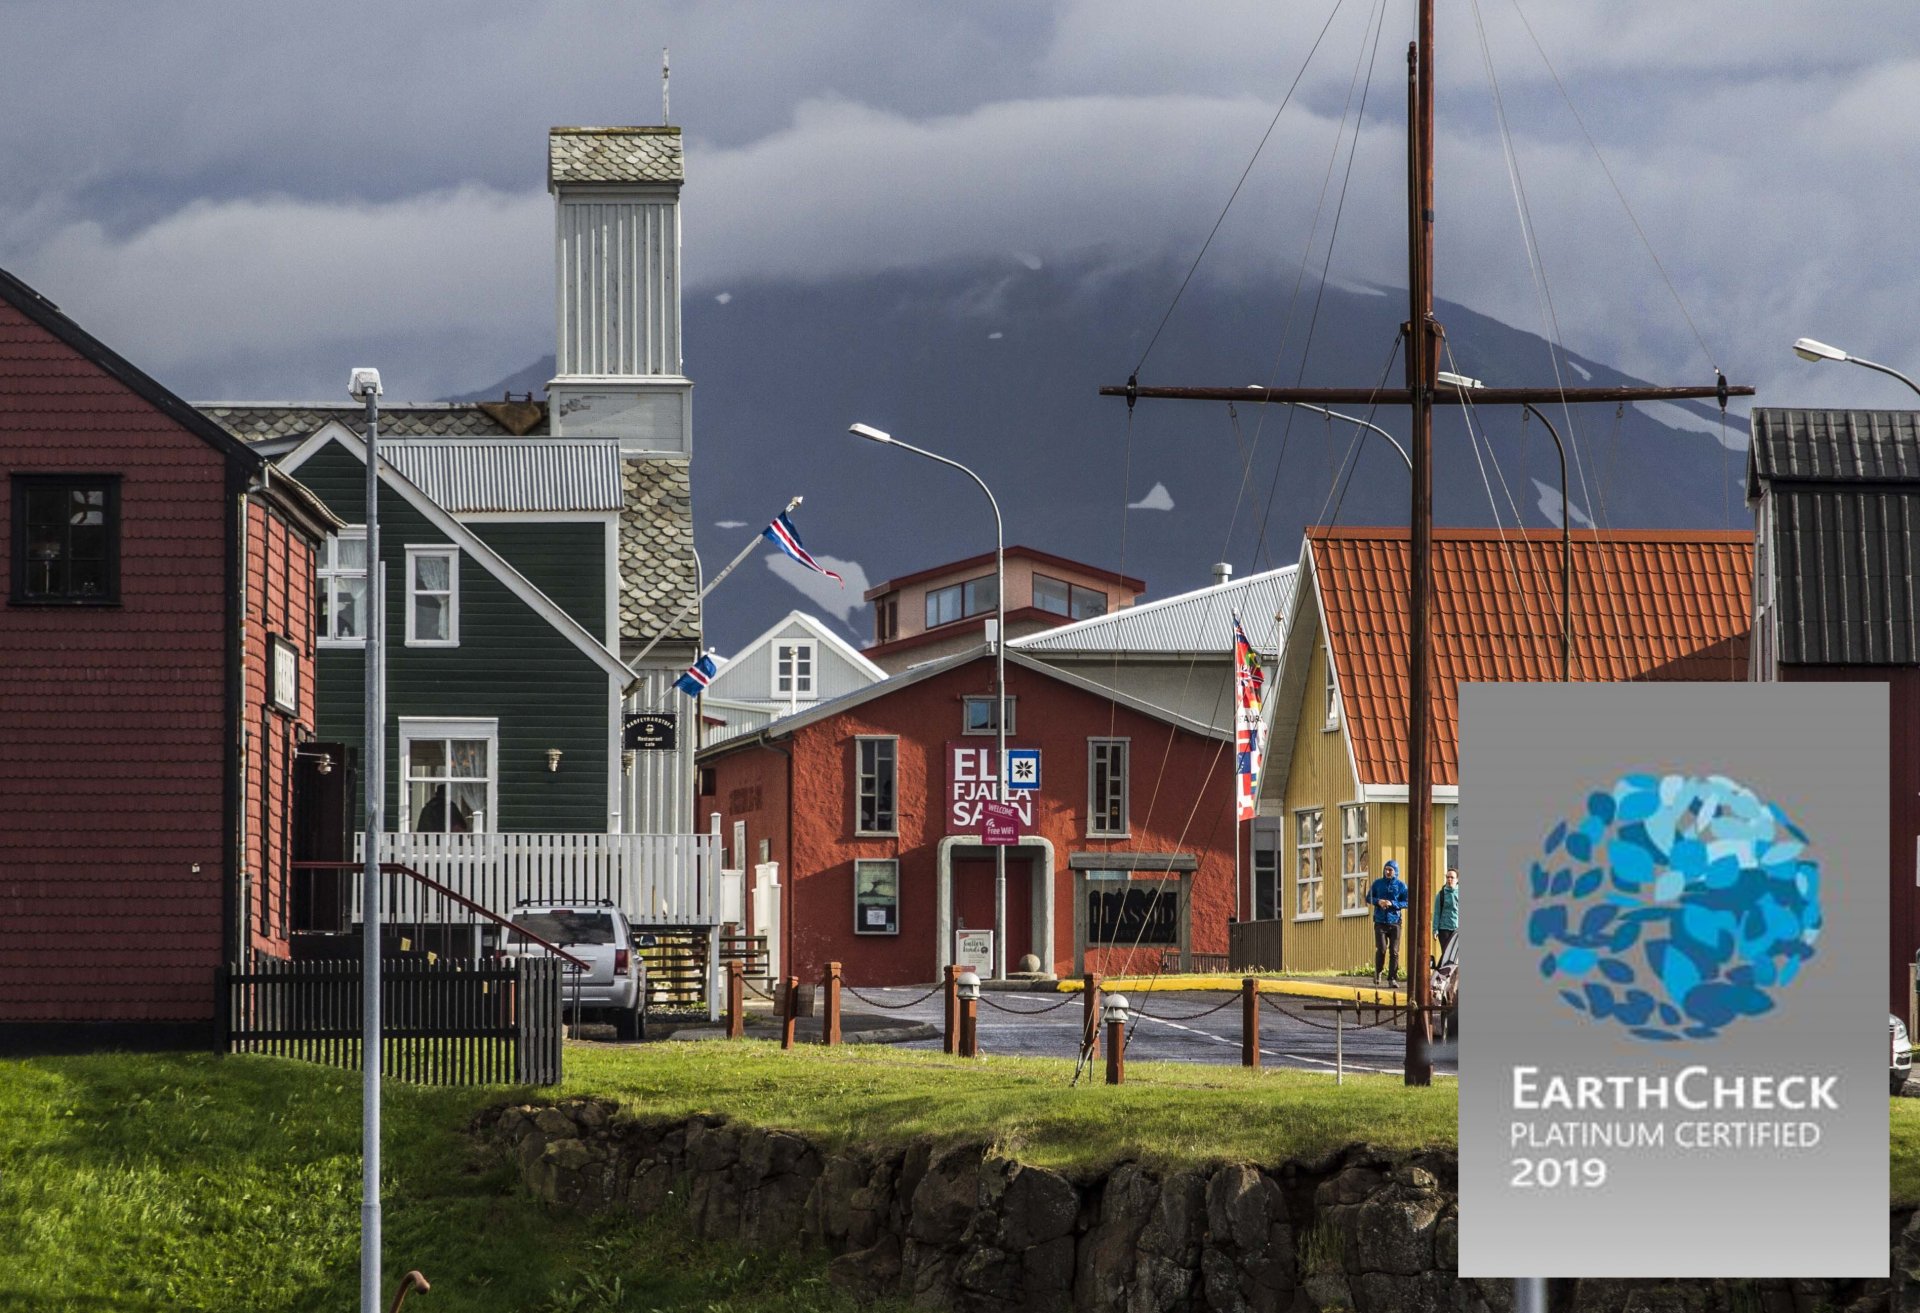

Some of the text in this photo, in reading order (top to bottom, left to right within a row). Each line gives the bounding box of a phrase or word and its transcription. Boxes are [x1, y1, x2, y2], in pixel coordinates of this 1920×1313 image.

[953, 801, 1032, 826] SAN
[988, 803, 1015, 817] WELCOME
[987, 826, 1000, 834] Free
